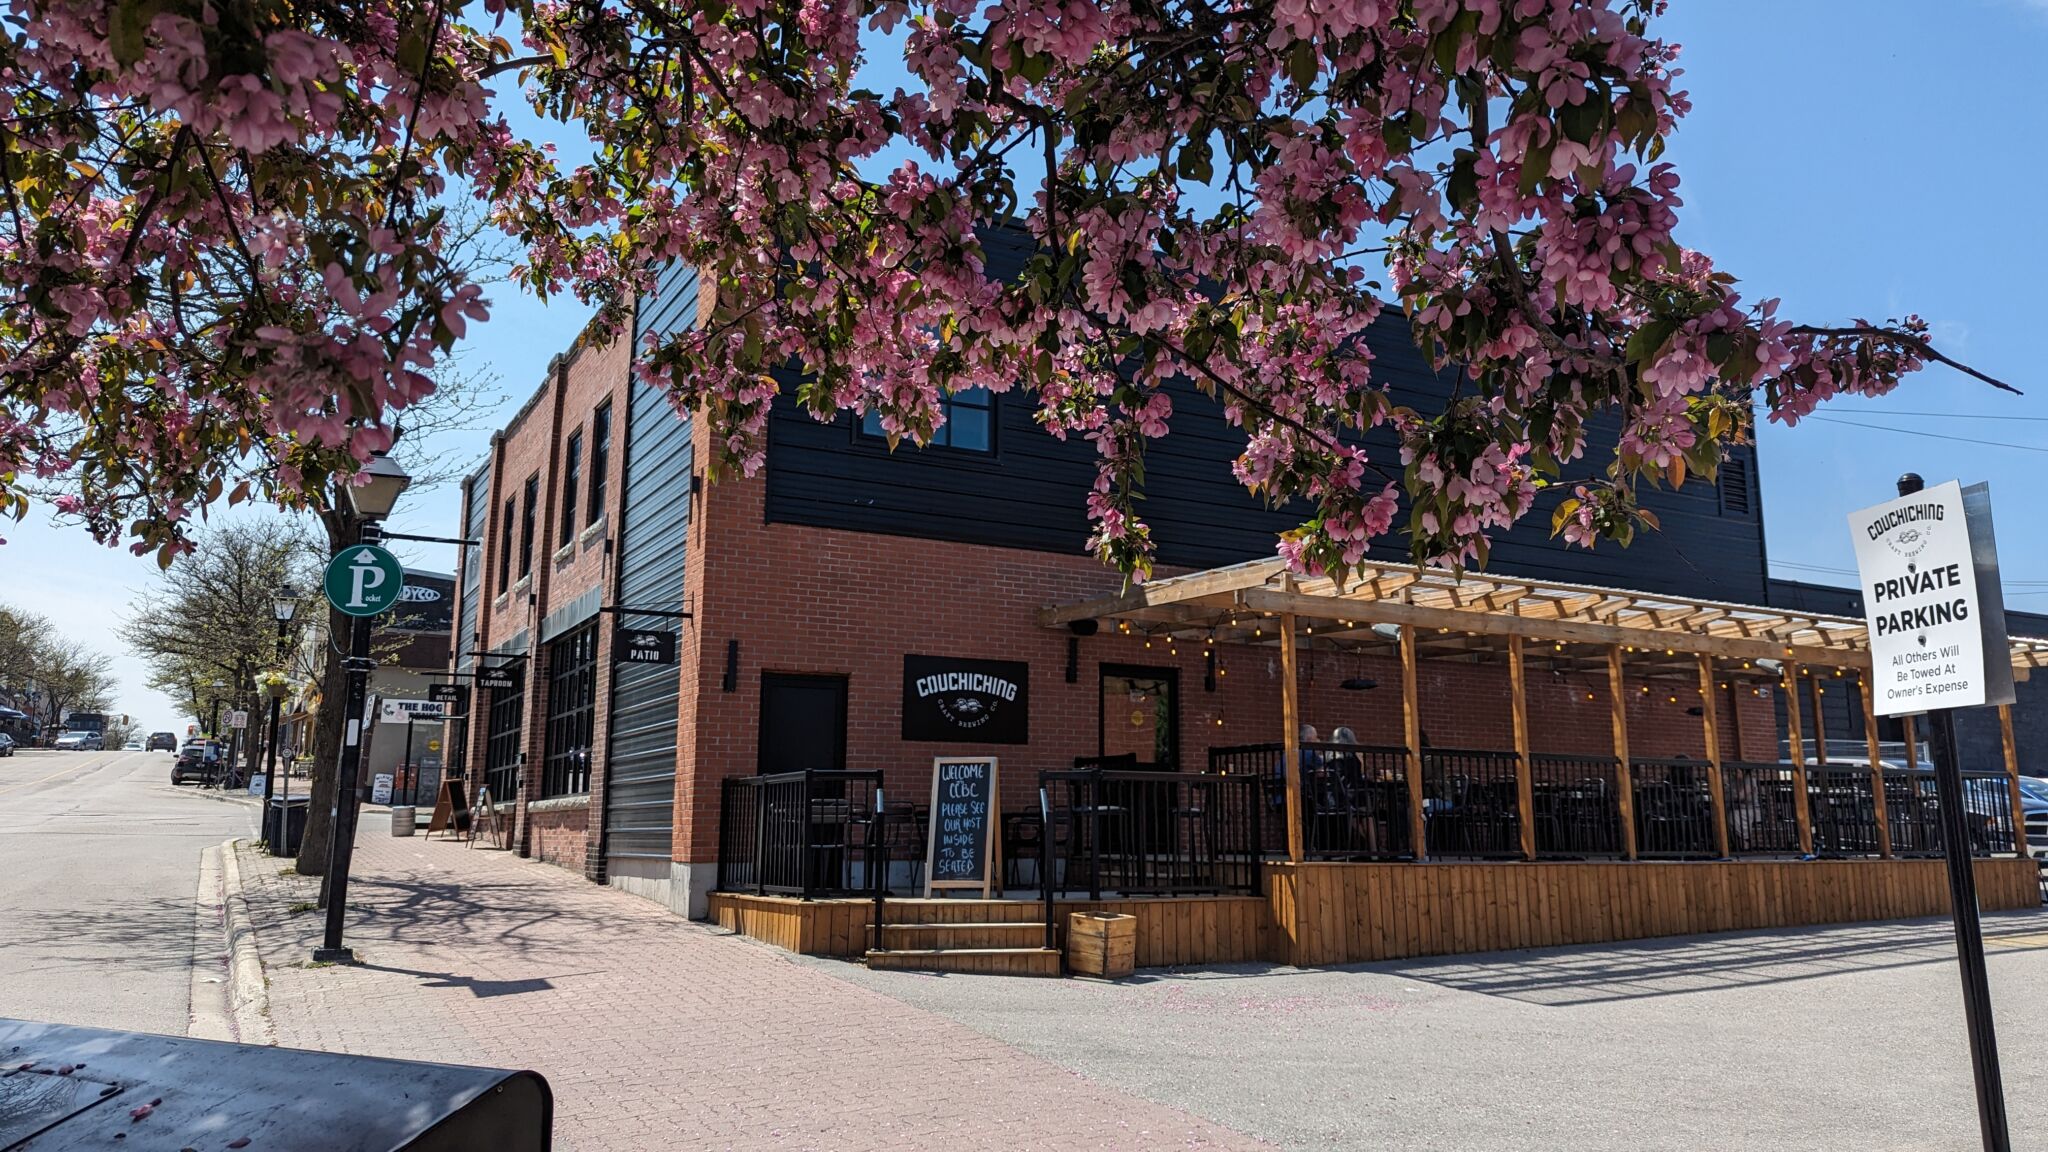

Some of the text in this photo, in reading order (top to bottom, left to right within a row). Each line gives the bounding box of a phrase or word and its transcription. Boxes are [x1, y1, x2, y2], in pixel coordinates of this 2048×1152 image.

[1867, 503, 1945, 541] COUCHICHING
[1874, 563, 1961, 603] PRIVATE
[400, 586, 434, 601] DYCO
[1876, 598, 1968, 636] PARKING
[630, 649, 660, 661] PATIO
[1892, 645, 1960, 667] All Others Will
[1897, 664, 1956, 682] Be Towed At
[480, 679, 513, 688] TAPROOM
[916, 672, 1018, 702] COUCHICHING
[1887, 679, 1969, 700] Owner's Expense
[435, 694, 458, 702] RETAIL
[398, 702, 443, 712] THE HOG
[937, 698, 955, 722] CRAFT
[958, 714, 989, 728] BREWING
[942, 764, 984, 781] WELCOME
[949, 782, 979, 798] CCBC
[941, 800, 985, 817] PLEASE SEE
[944, 817, 982, 833] OUR HOST
[943, 833, 975, 846] INSIDE
[941, 848, 975, 859] TO BE
[938, 859, 975, 875] SEATED
